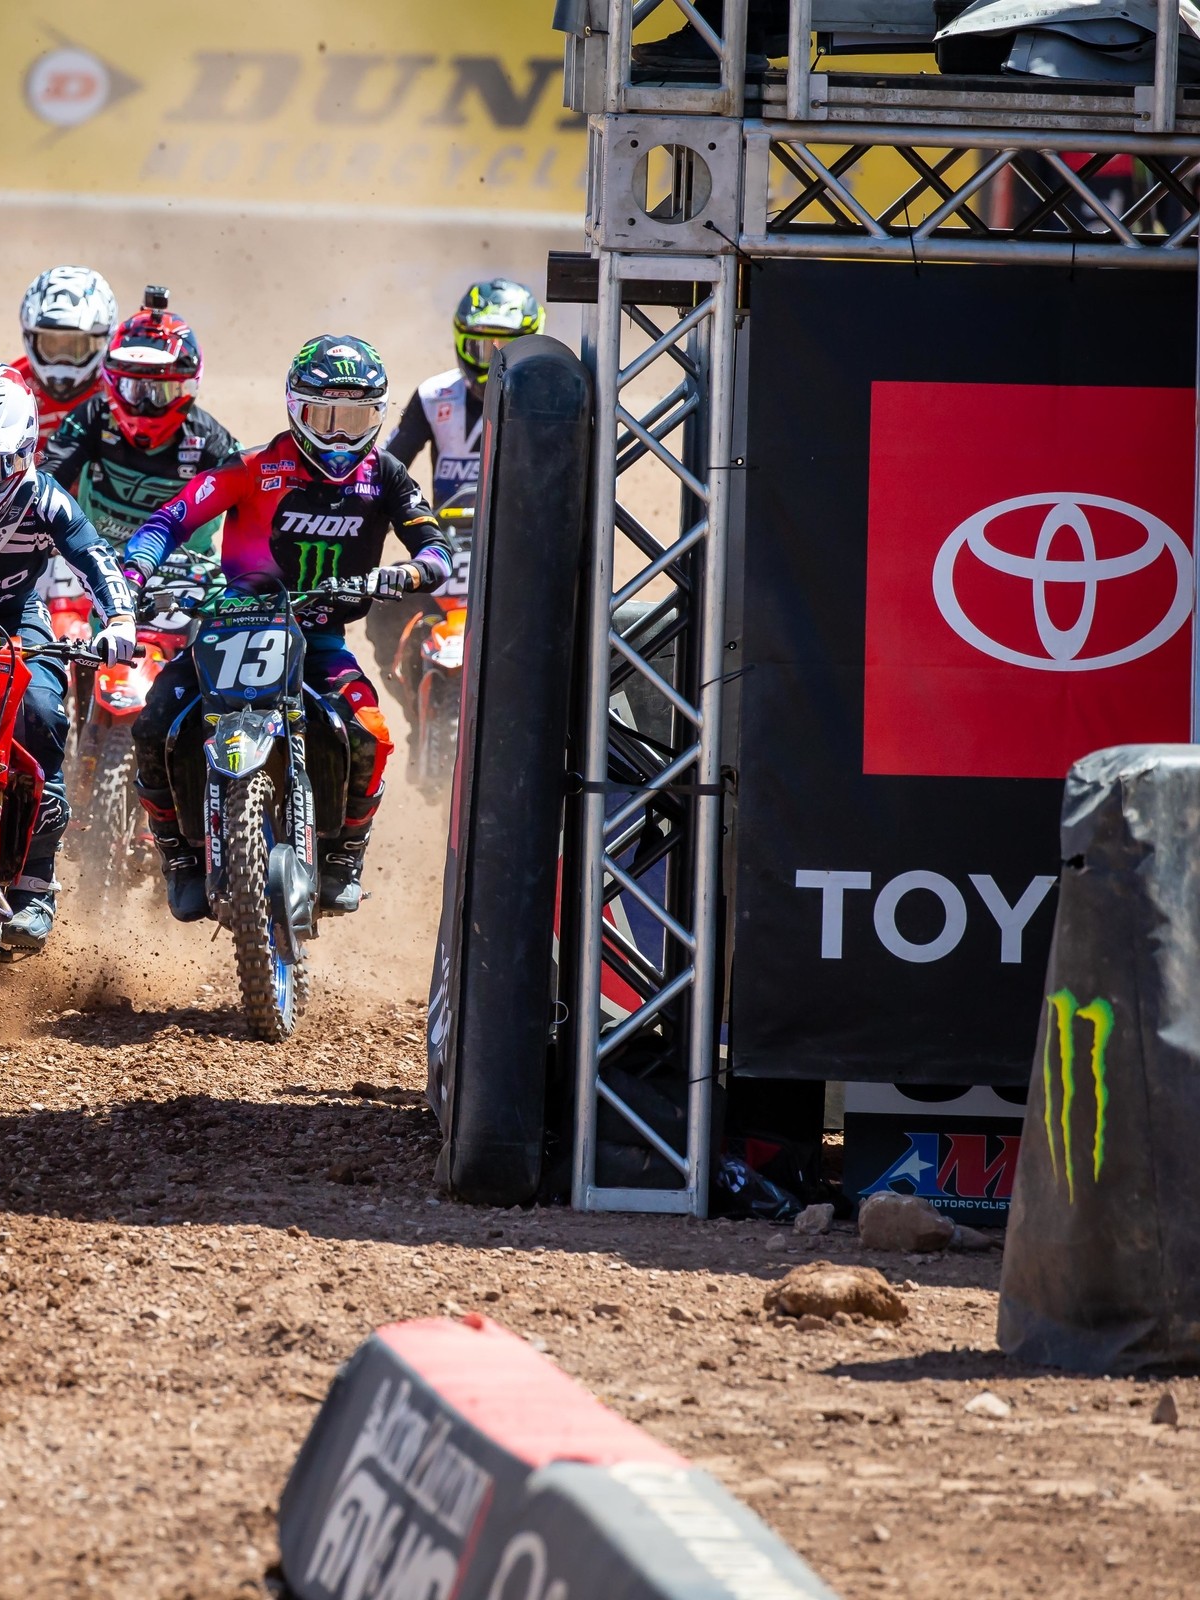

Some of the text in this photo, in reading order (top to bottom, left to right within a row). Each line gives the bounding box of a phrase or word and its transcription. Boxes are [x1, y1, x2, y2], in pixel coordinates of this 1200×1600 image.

[162, 50, 592, 132] DUN
[280, 511, 364, 537] THOR
[232, 616, 270, 625] MONSTER
[214, 630, 293, 690] 13
